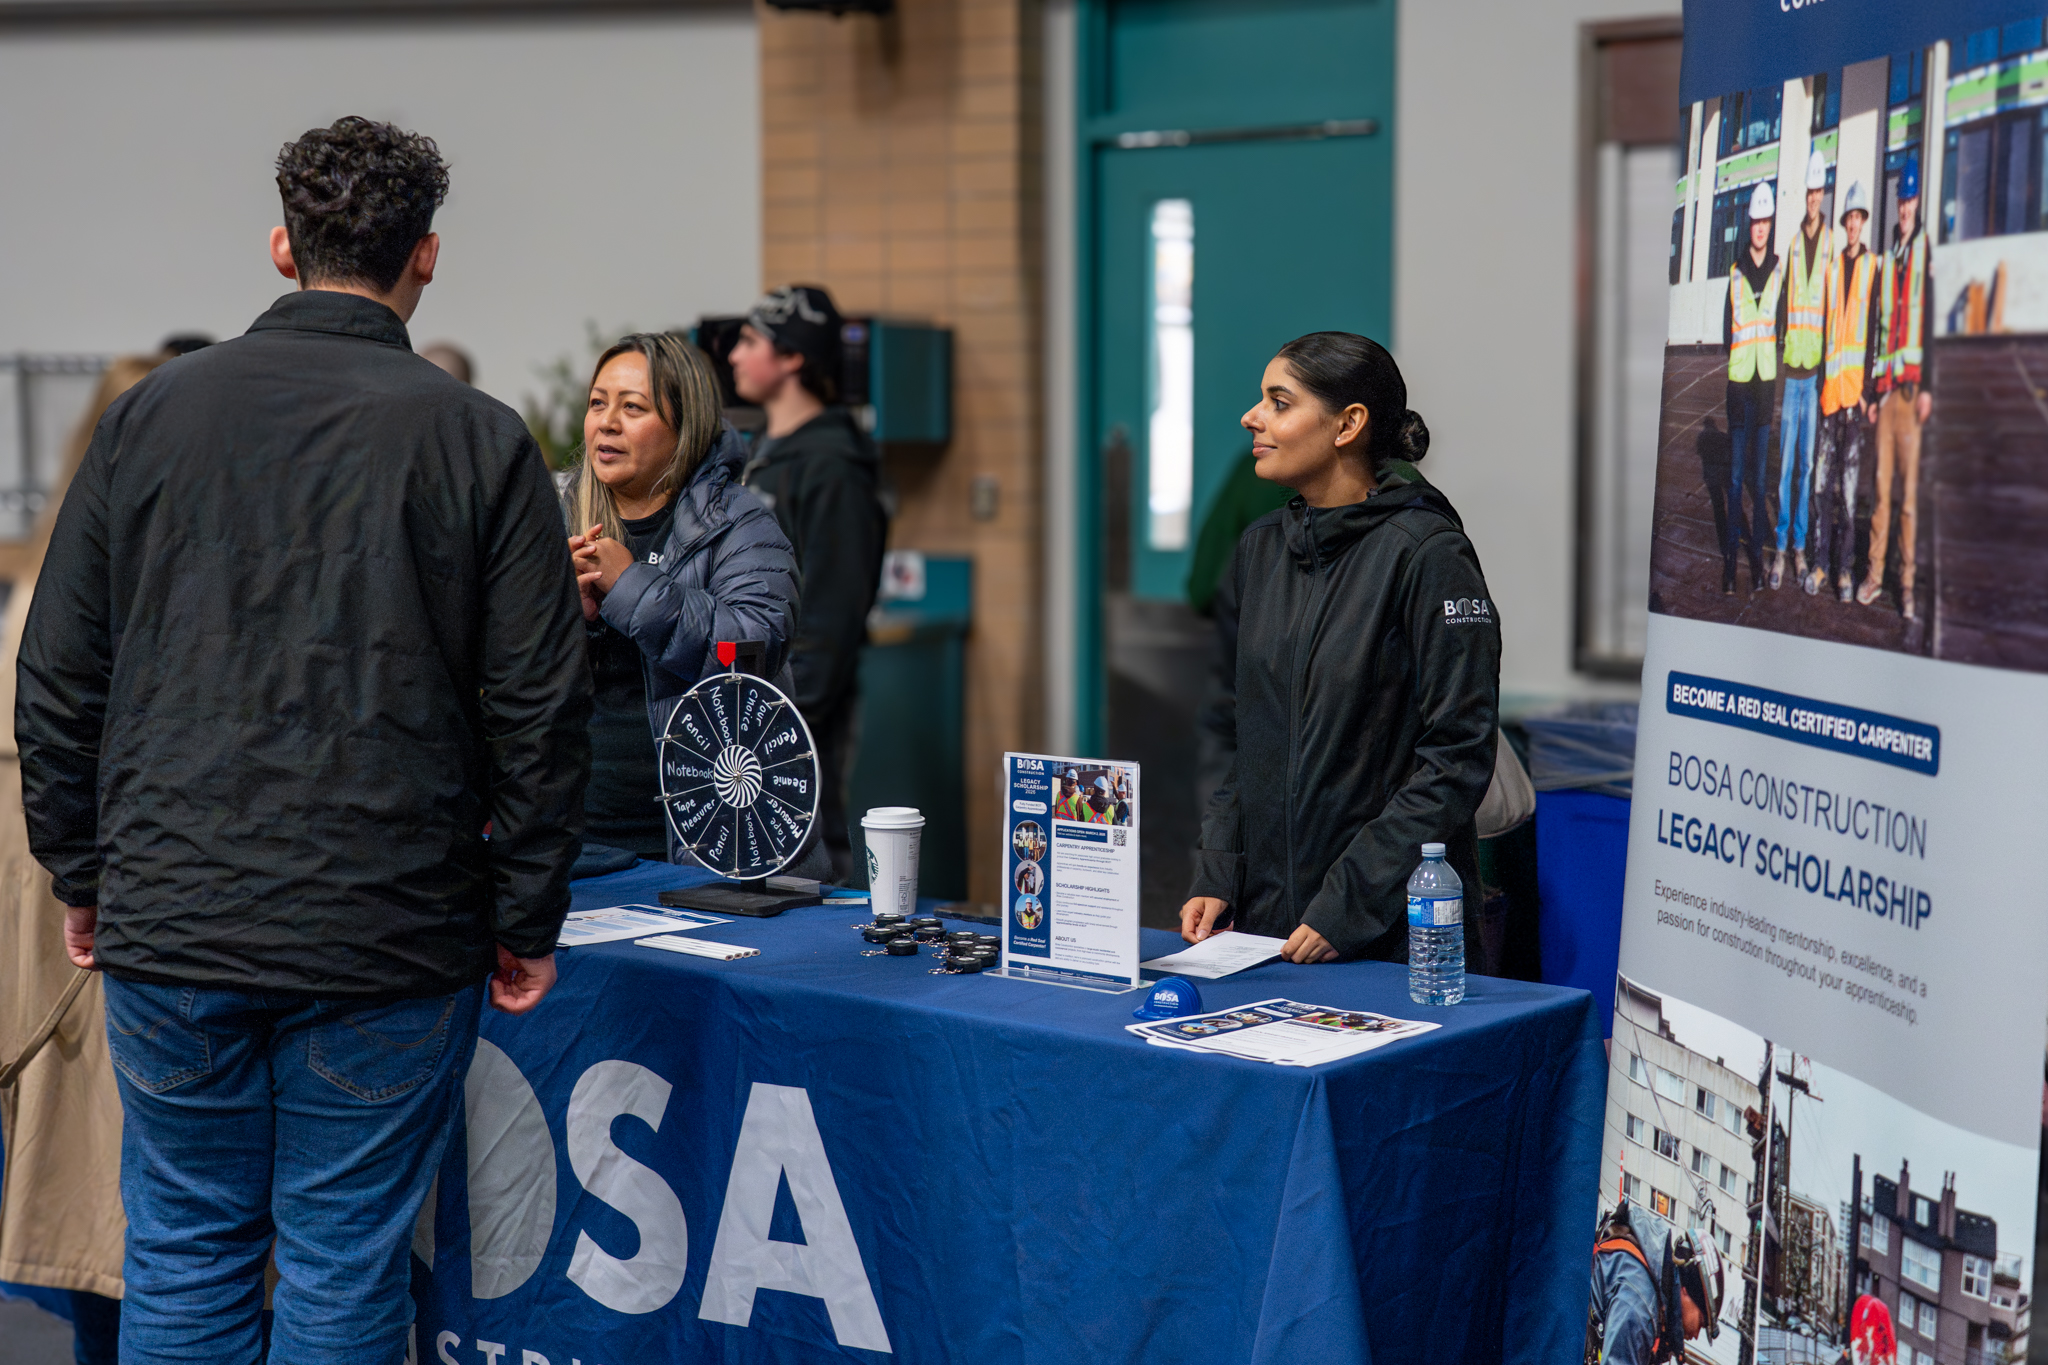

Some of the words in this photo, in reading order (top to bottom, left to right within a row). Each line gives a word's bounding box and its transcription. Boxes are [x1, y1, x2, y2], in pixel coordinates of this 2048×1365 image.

[1444, 598, 1490, 615] BOSA
[681, 713, 711, 751] Pencil
[709, 686, 733, 747] Notebook
[1673, 684, 1725, 711] BECOME
[1726, 694, 1735, 712] A
[1737, 696, 1761, 718] RED
[1762, 705, 1789, 727] SEAL
[1791, 708, 1856, 742] CERTIFIED
[1858, 724, 1932, 761] CARPENTER
[765, 727, 798, 756] Pencil
[667, 761, 714, 780] Notebook
[1017, 759, 1044, 771] BOSA
[773, 775, 807, 794] Beanie
[673, 798, 696, 813] Tape
[681, 799, 716, 832] Measurer
[767, 798, 804, 839] Measurer
[1668, 751, 1733, 801] BOSA
[1739, 769, 1927, 860] CONSTRUCTION
[709, 825, 730, 862] Pencil
[745, 812, 762, 867] Notebook
[770, 817, 787, 848] Tape
[1657, 809, 1751, 867] LEGACY
[1755, 838, 1932, 930] SCHOLARSHIP
[1654, 880, 1707, 911] Experience
[1710, 897, 1776, 942] industry-leading
[1779, 925, 1838, 964] mentorship,
[1841, 949, 1895, 987] excellence,
[1898, 971, 1918, 994] and
[1920, 982, 1927, 998] a
[1657, 908, 1694, 933] passion
[1697, 920, 1710, 938] for
[1712, 927, 1763, 960] construction
[1765, 945, 1815, 984] throughout
[1819, 970, 1842, 992] your
[1845, 980, 1919, 1026] apprenticeship.
[1154, 992, 1179, 1003] BOSA
[412, 1036, 893, 1353] OSA
